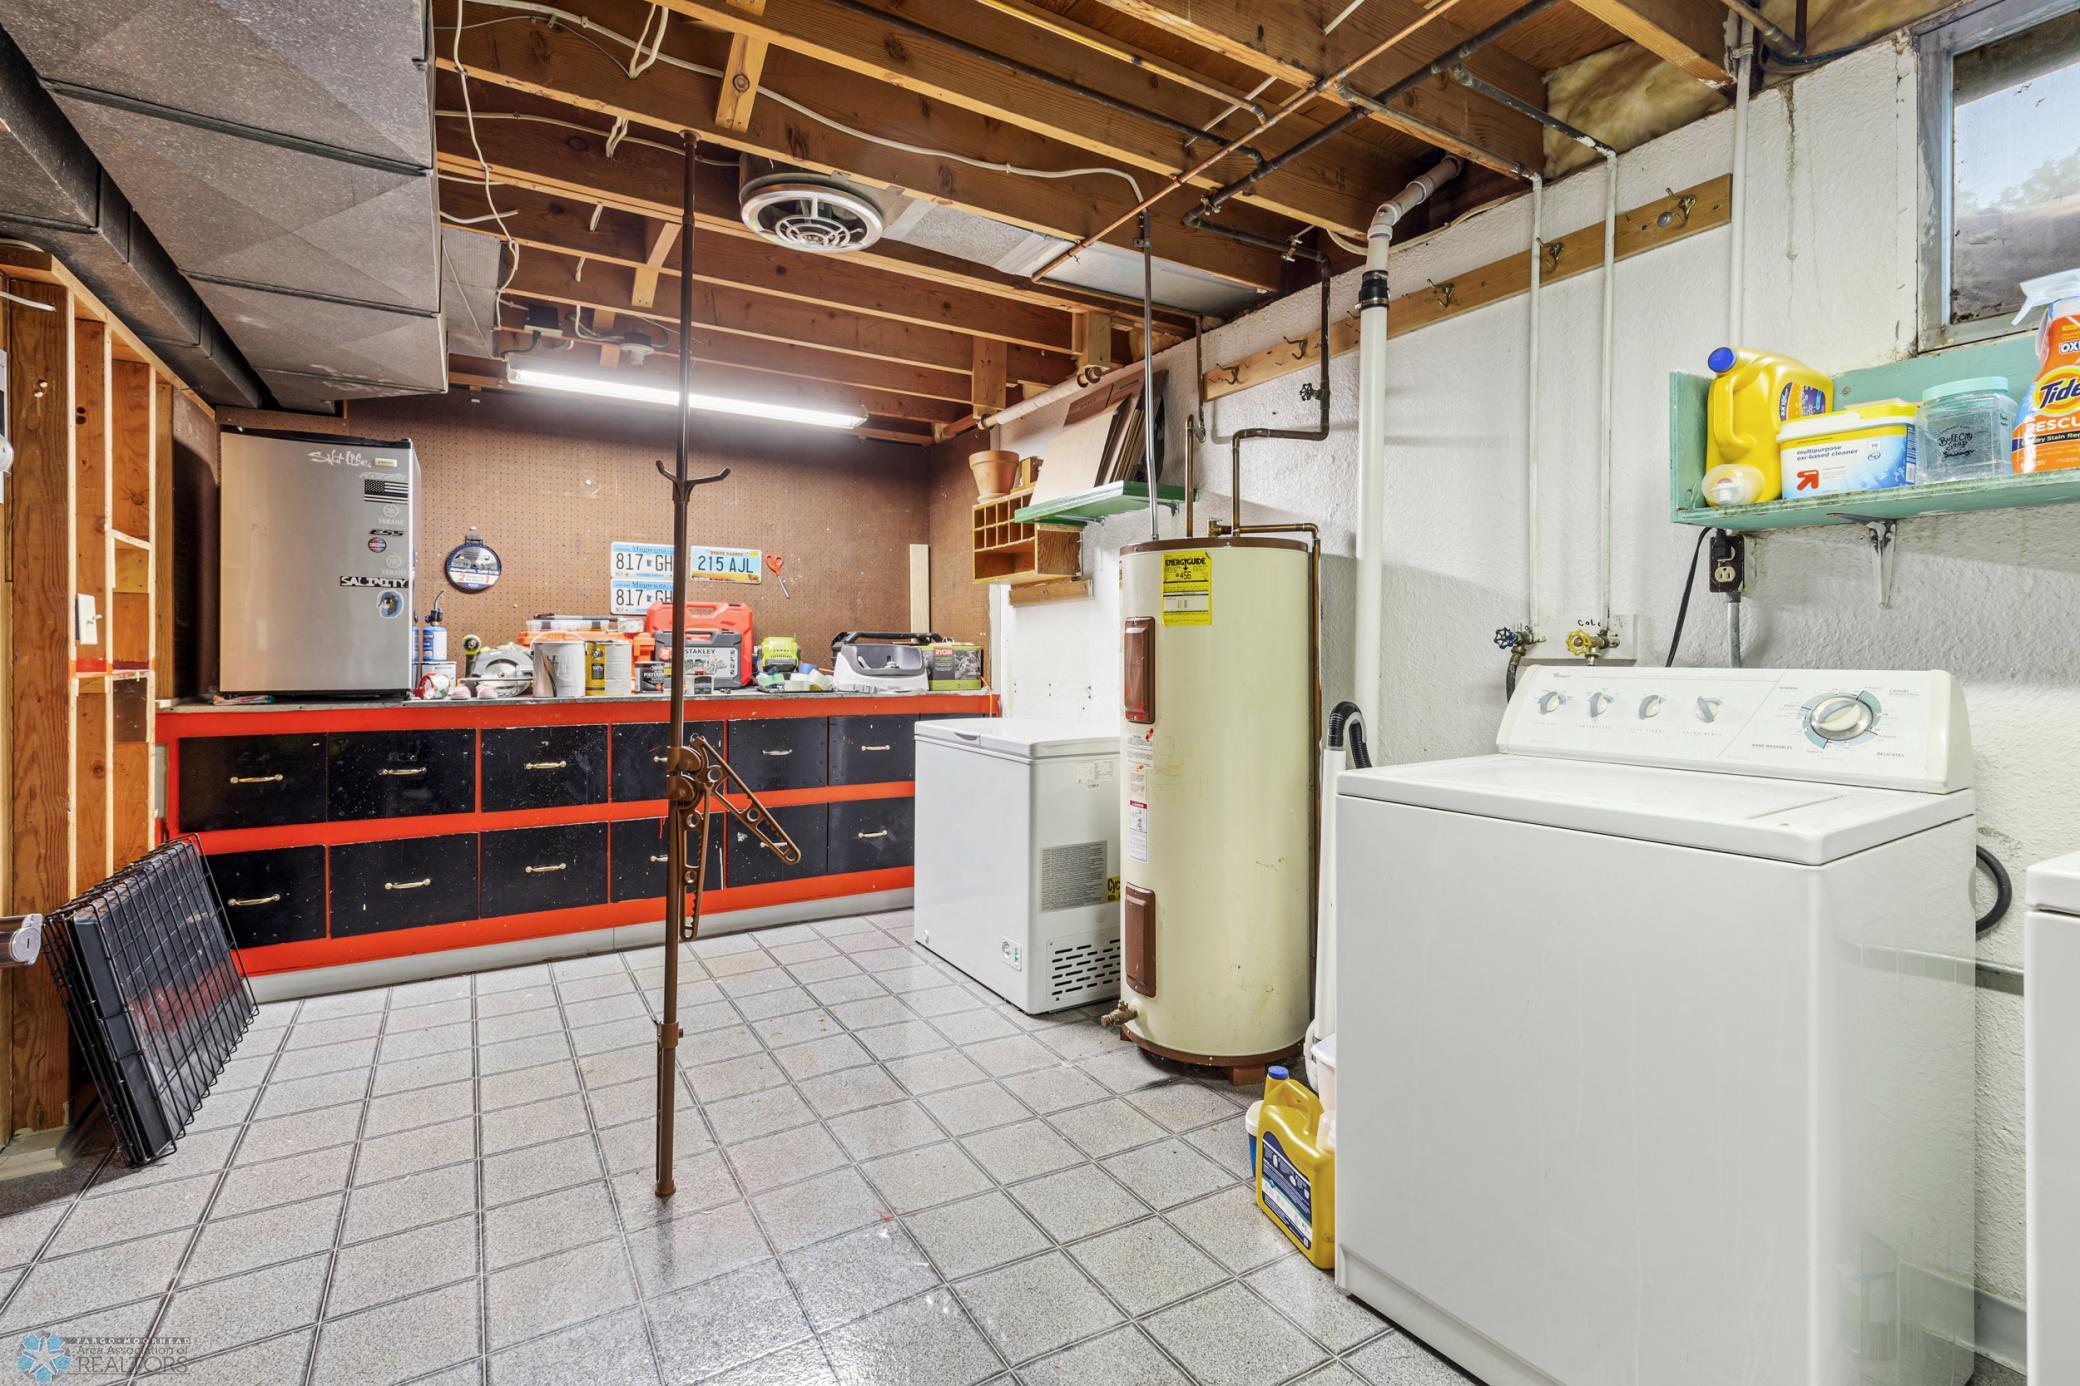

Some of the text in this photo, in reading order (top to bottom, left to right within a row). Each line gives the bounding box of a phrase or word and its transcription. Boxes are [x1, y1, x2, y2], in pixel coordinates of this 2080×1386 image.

[2040, 378, 2080, 409] Tide
[1939, 433, 1958, 446] Buff
[1796, 444, 1842, 456] multipurpose
[1831, 448, 1858, 457] cleaner
[616, 552, 644, 571] 817
[698, 555, 754, 574] 215 AJL
[341, 576, 406, 588] SALINITY
[616, 588, 644, 607] 817
